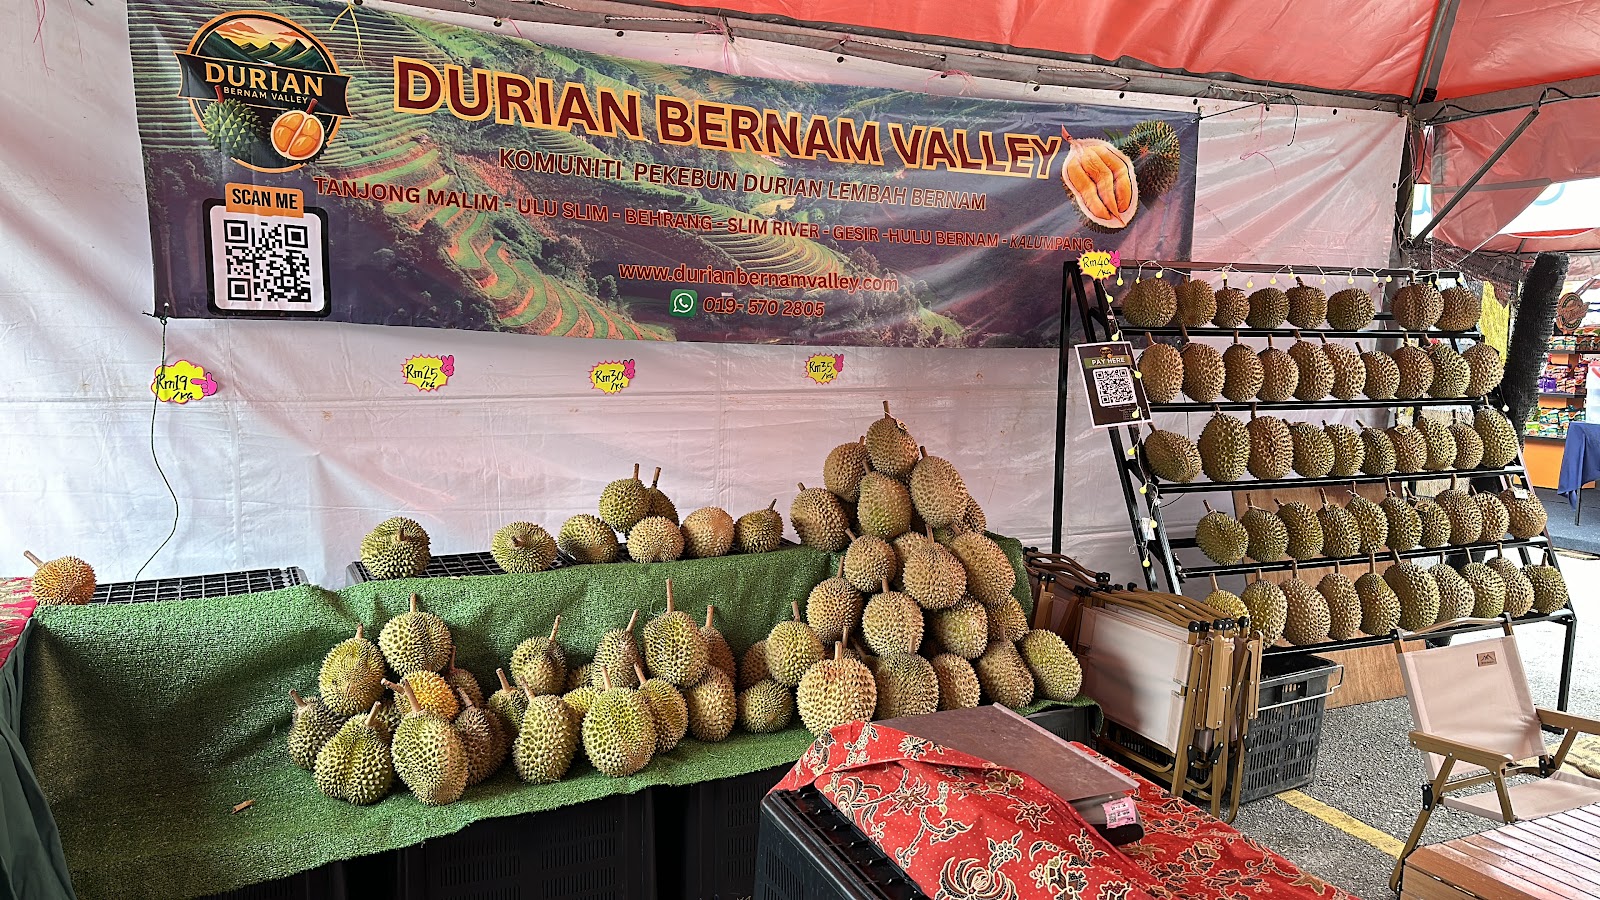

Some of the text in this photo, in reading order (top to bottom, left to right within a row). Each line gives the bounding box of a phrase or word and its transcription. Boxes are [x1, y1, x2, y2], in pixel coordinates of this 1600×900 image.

[204, 61, 323, 97] DURIAN
[223, 86, 308, 105] BERNAM VALLEY
[393, 56, 1063, 180] DURIAN BERNAM VALLEY
[499, 148, 987, 211] KOMUNITI PEKEBUN DURIAN LEMBAH BERNAM
[232, 188, 298, 209] SCAN ME
[313, 176, 421, 204] TANJONG
[426, 188, 499, 212] MALIM
[517, 198, 558, 217] ULU
[561, 202, 609, 222] SLIM
[624, 208, 713, 230] BEHRANG
[727, 217, 768, 235] SLIM
[771, 222, 820, 239] RIVER
[832, 225, 880, 242] GESIR
[935, 231, 999, 248] BERNAM
[1009, 234, 1094, 252] KALUMPANG
[1082, 256, 1110, 268] Rm40
[618, 262, 899, 295] www.durianbernamvalley.com
[702, 296, 825, 318] 019- 570 2805
[809, 360, 833, 373] Rm35
[1107, 356, 1126, 364] HERE
[156, 373, 188, 391] Rm19
[406, 363, 438, 381] Rm25
